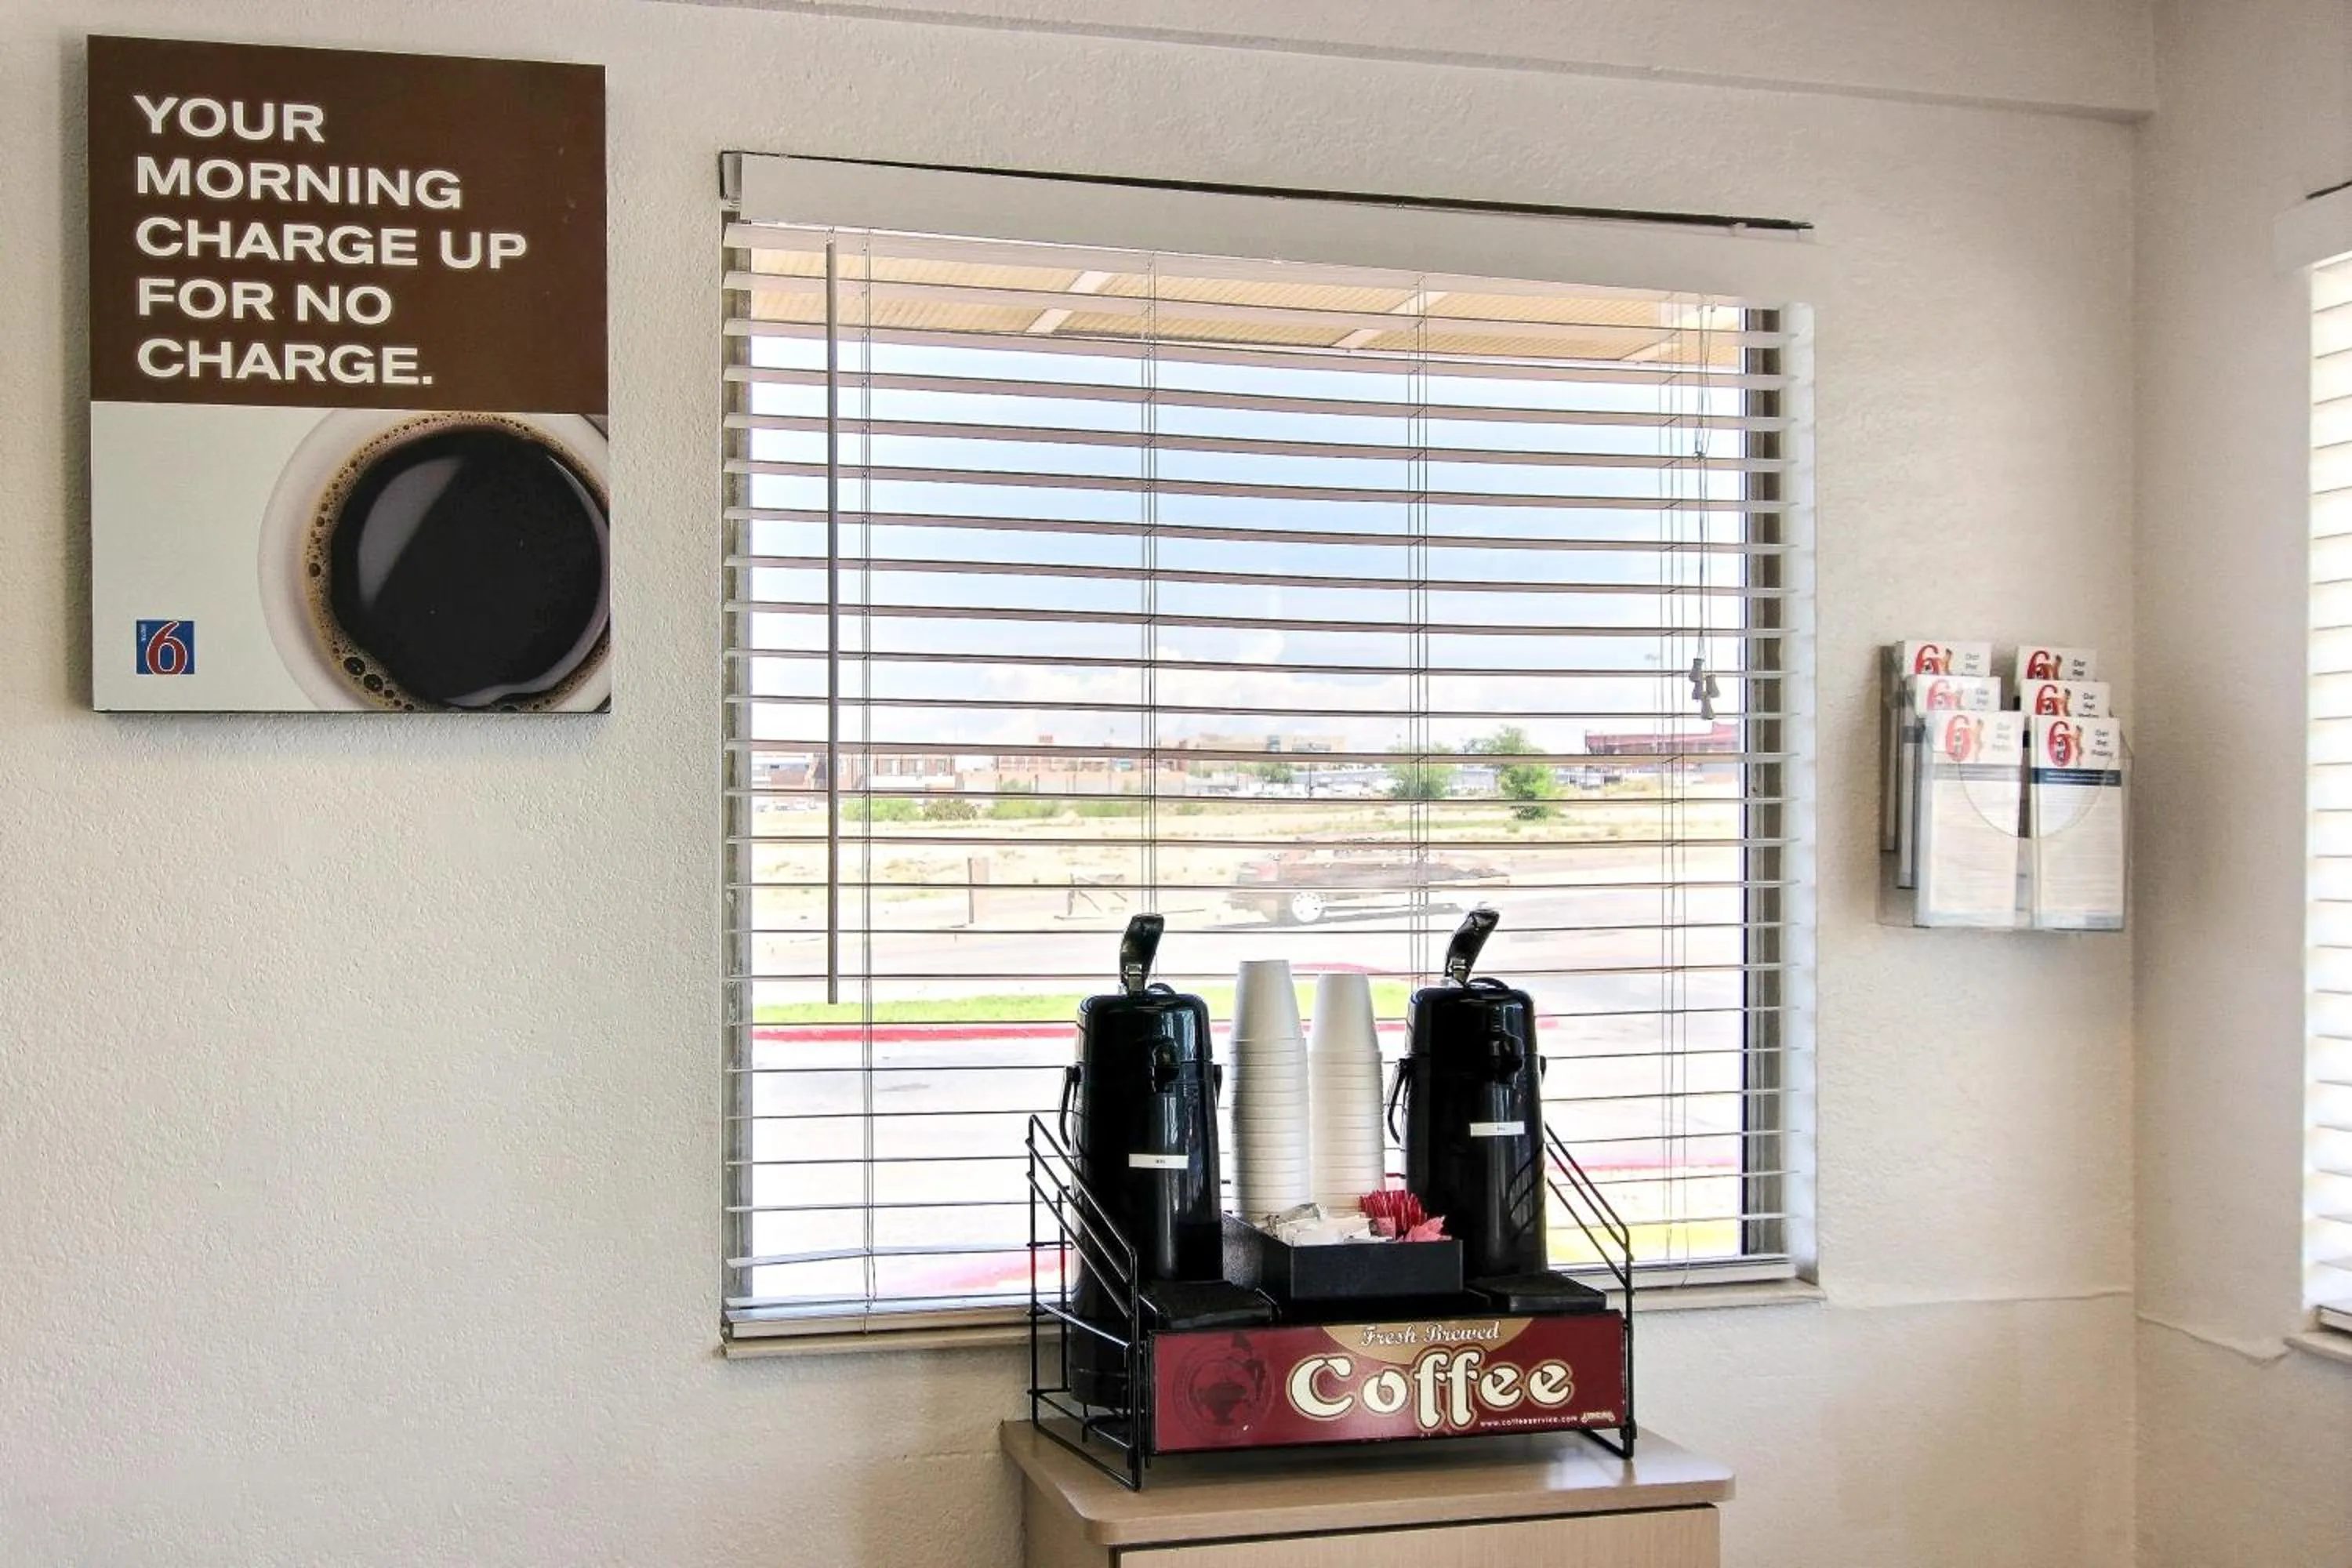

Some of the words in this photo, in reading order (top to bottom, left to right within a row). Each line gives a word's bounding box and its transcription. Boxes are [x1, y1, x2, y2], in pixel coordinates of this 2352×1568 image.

[133, 95, 326, 143] YOUR
[136, 156, 462, 209] MORNING
[136, 216, 419, 267] CHARGE
[440, 230, 528, 270] UP
[138, 278, 276, 321] FOR
[296, 284, 394, 325] NO
[136, 338, 434, 385] CHARGE.
[146, 621, 188, 675] 6
[1361, 1325, 1417, 1346] Fresh
[1423, 1320, 1501, 1342] Brewed
[1287, 1346, 1573, 1432] Coffee
